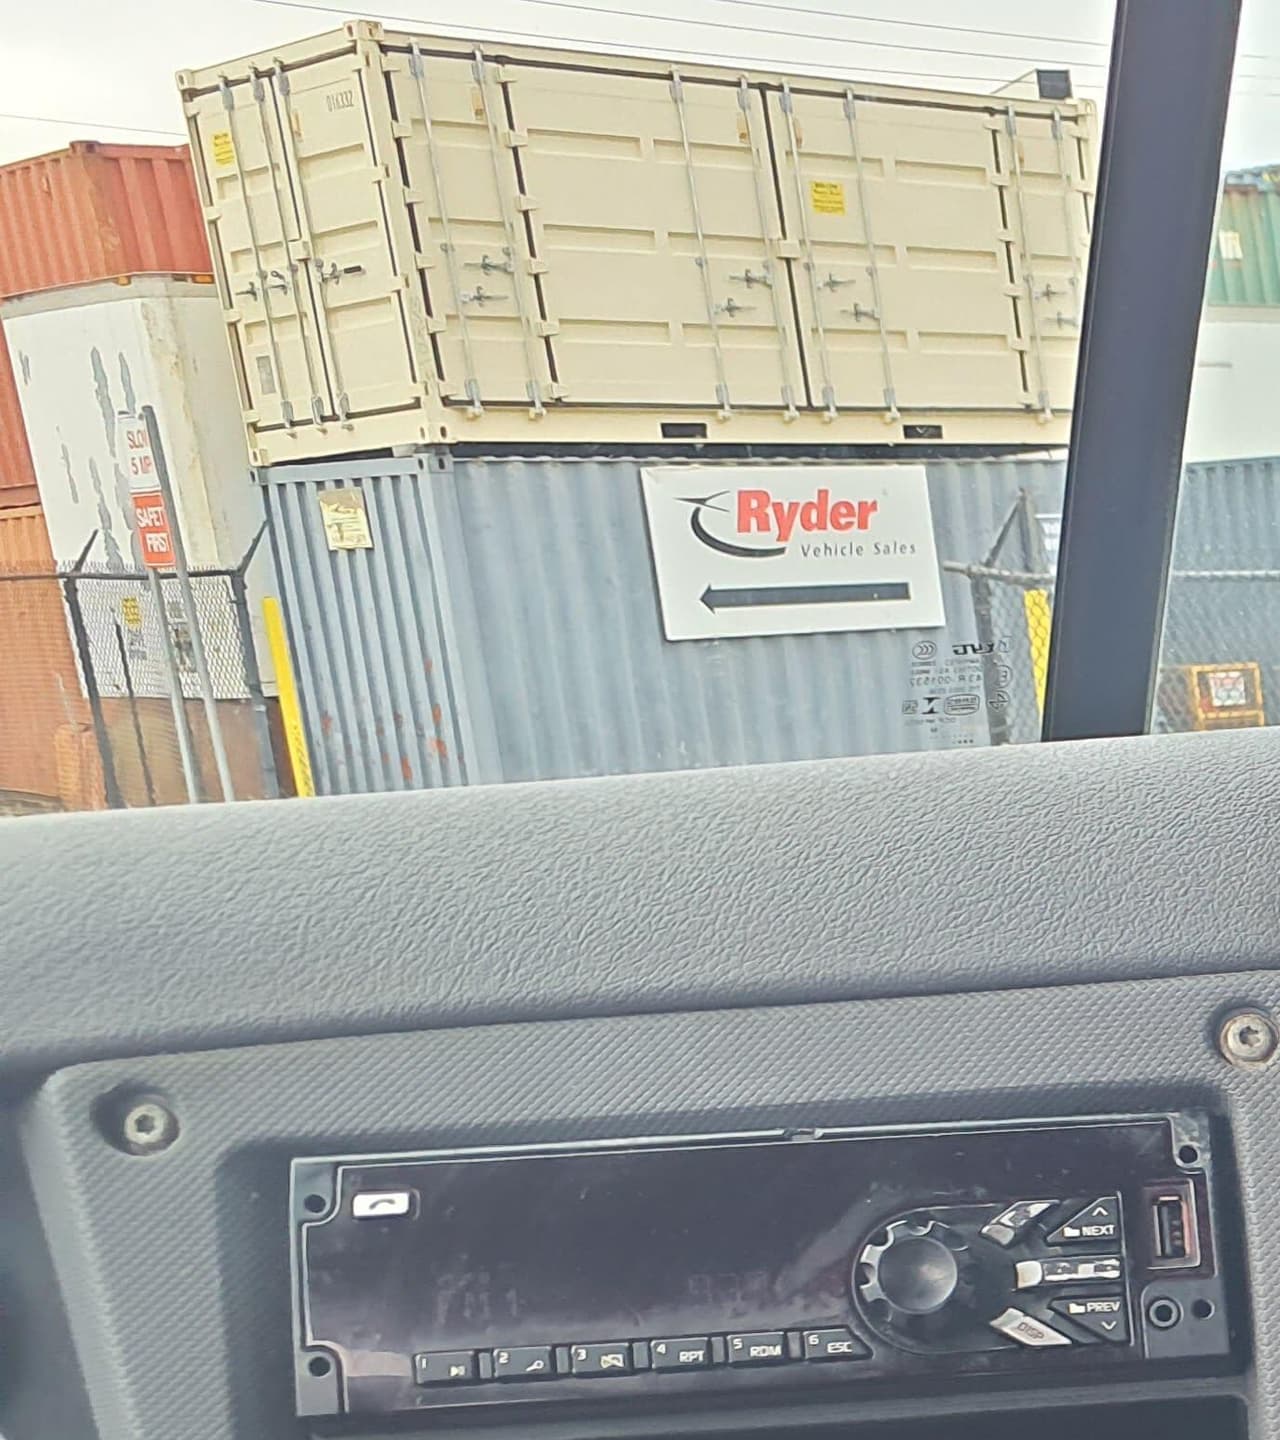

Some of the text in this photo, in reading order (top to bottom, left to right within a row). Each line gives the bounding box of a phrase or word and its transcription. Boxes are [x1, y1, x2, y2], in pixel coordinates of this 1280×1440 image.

[136, 506, 165, 528] SAFET
[737, 489, 877, 542] Ryder
[800, 542, 916, 558] Vehicle Sales
[1082, 1225, 1115, 1236] NEXT
[1086, 1302, 1120, 1312] PREV
[1016, 1322, 1045, 1340] DISP
[733, 1338, 742, 1349] 5
[809, 1335, 819, 1345] 6
[656, 1343, 666, 1354] 4
[750, 1344, 781, 1357] RDM
[827, 1341, 852, 1354] ESC
[499, 1352, 508, 1363] 2
[577, 1350, 587, 1360] 3
[679, 1350, 704, 1363] RPT
